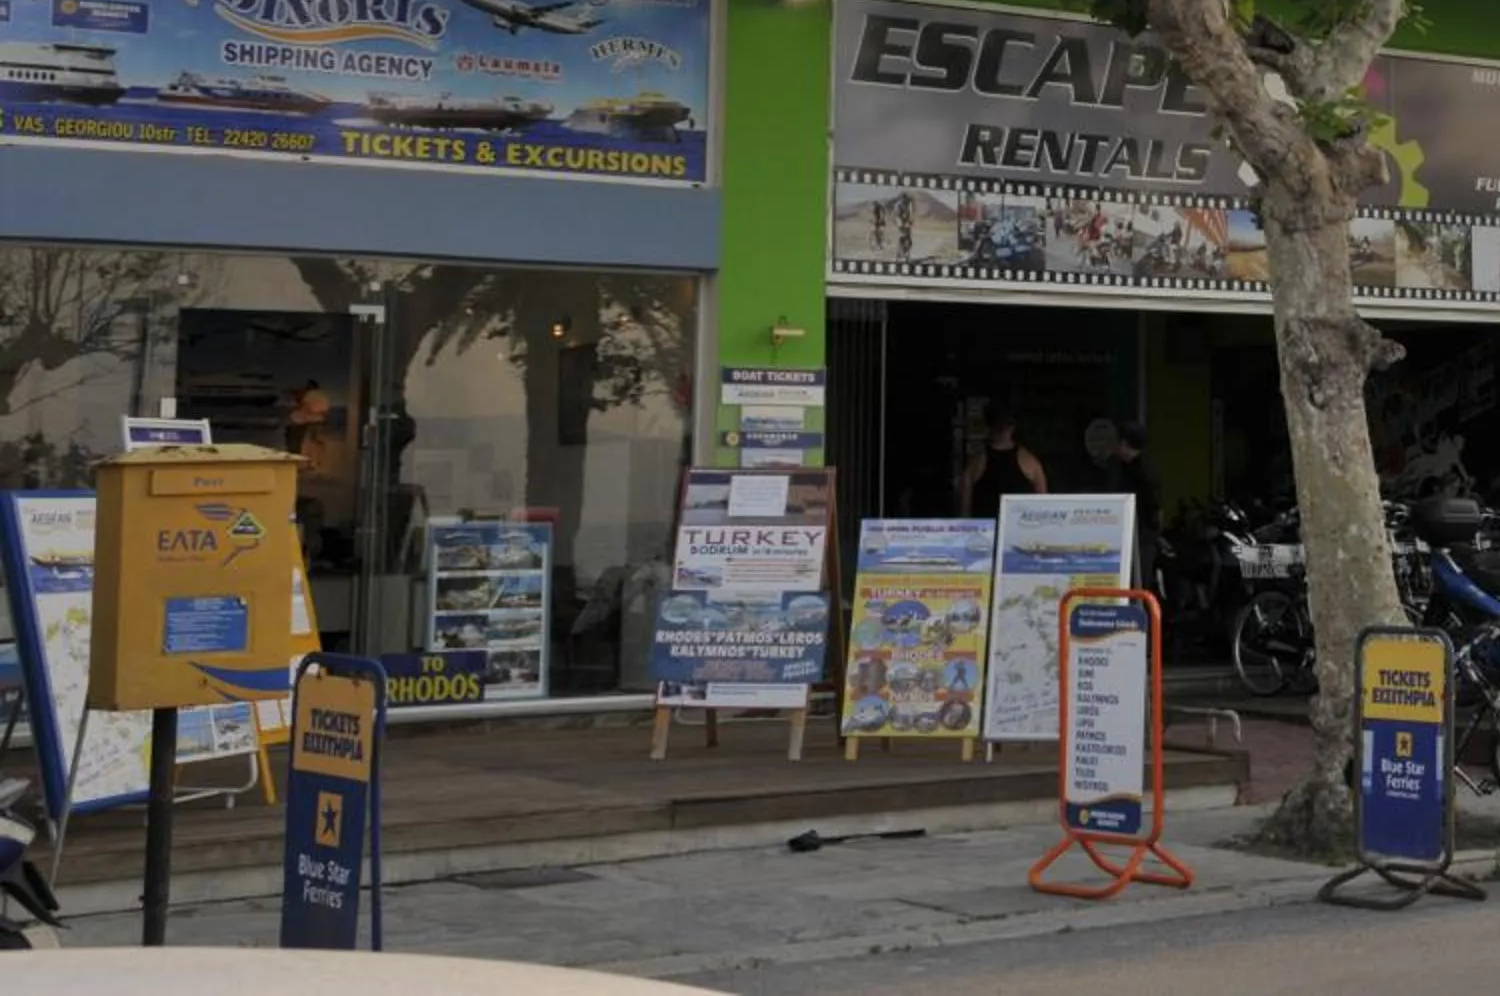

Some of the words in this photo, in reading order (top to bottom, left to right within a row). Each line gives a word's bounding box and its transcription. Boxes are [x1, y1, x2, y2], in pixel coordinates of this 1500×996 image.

[223, 42, 335, 71] SHIPPING
[342, 51, 434, 79] AGENCY
[54, 118, 133, 140] GEORGIOU
[222, 129, 267, 148] 22420
[341, 130, 466, 161] TICKETS
[474, 141, 496, 163] &
[507, 142, 686, 176] EXCURSIONS
[956, 122, 1212, 184] RENTALS
[731, 370, 763, 381] BOAT
[767, 371, 816, 383] TICKETS
[157, 530, 218, 552] ΕΛΤΑ
[684, 530, 823, 547] TURKEY
[421, 655, 444, 672] TO
[386, 673, 481, 702] RHODOS
[1379, 670, 1431, 686] TICKETS
[312, 708, 361, 735] TICKETS
[1382, 759, 1403, 773] Blue
[1406, 760, 1425, 776] Star
[1386, 775, 1420, 791] Ferries
[297, 853, 325, 879] Blue
[327, 859, 352, 885] Star
[303, 879, 344, 909] Ferries
